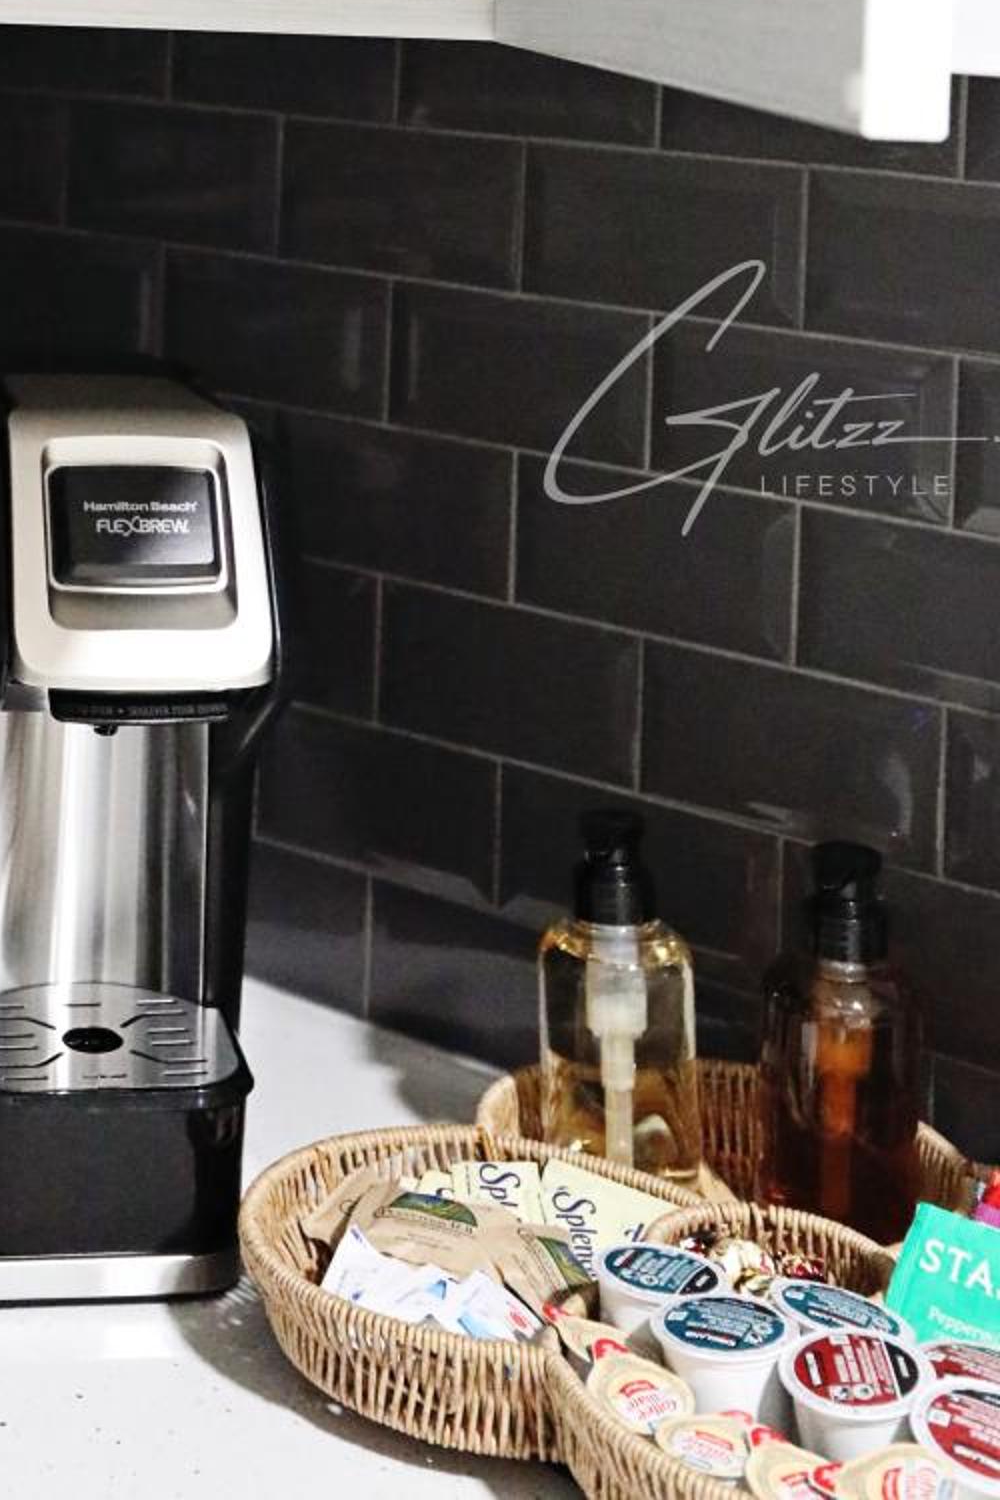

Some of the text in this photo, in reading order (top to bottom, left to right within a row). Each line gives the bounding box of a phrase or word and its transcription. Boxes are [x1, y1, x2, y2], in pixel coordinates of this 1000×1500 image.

[83, 501, 198, 513] Hamilton Beach
[919, 1238, 1000, 1301] STA
